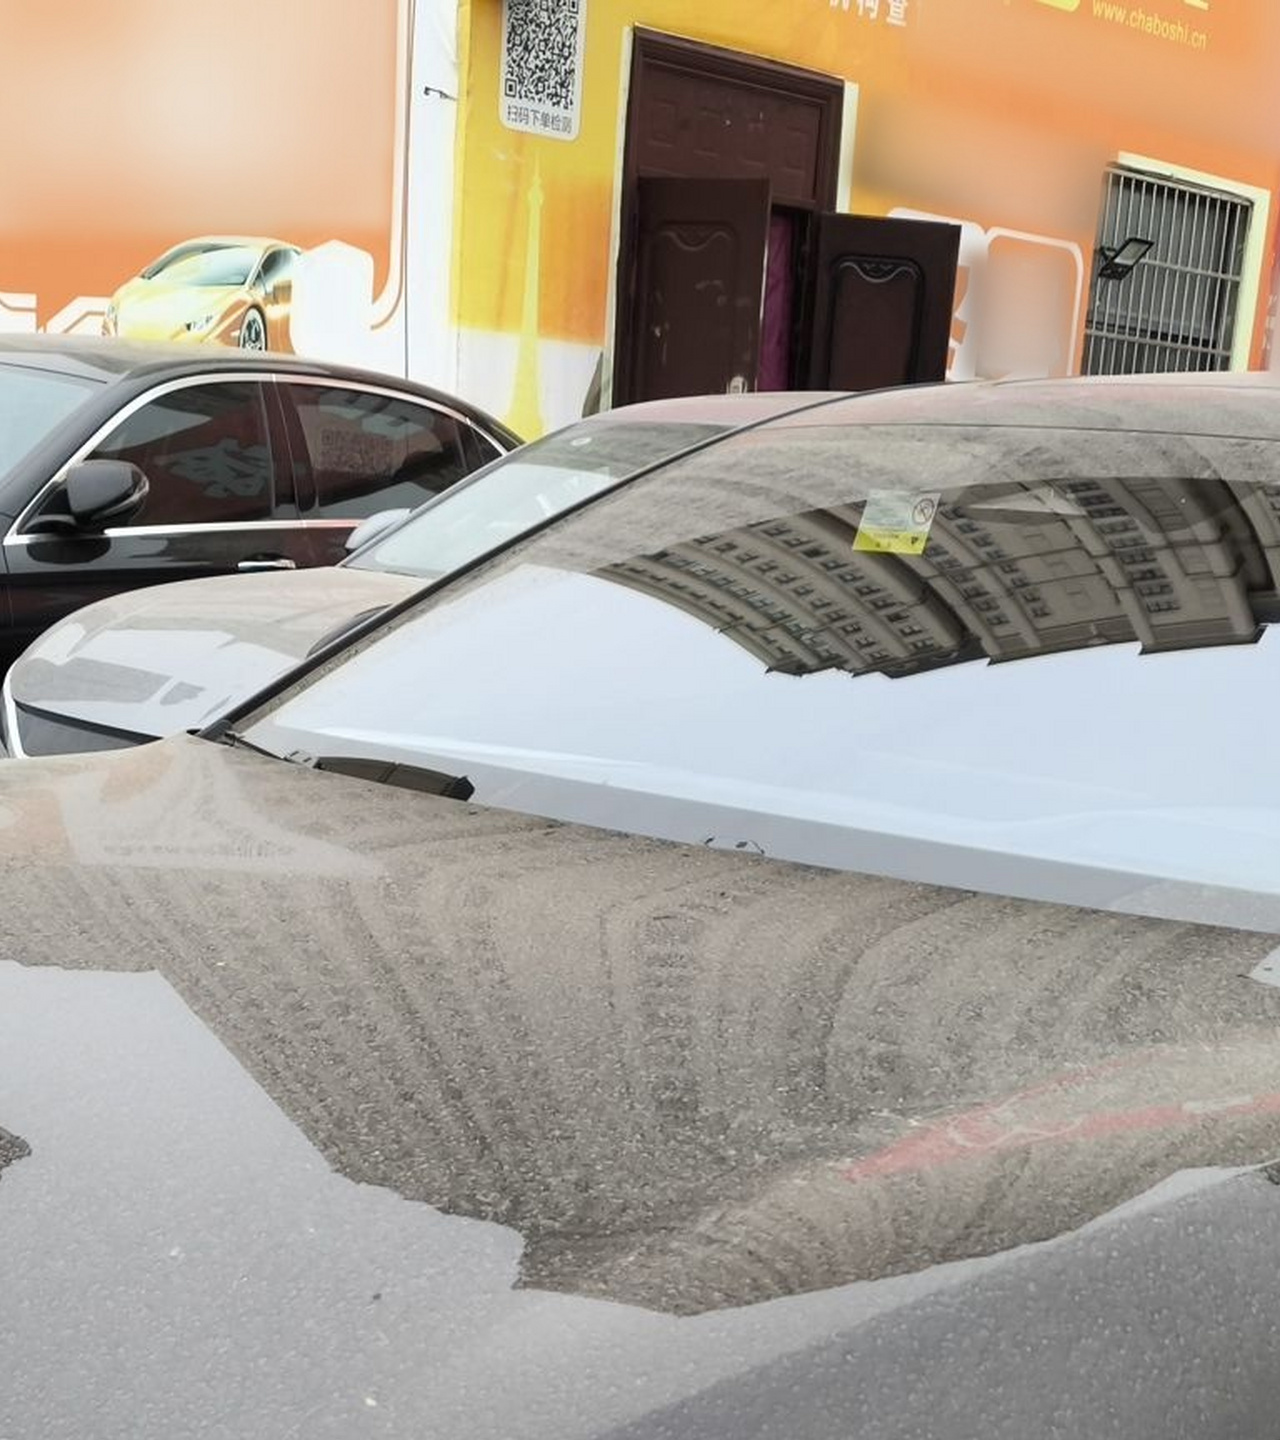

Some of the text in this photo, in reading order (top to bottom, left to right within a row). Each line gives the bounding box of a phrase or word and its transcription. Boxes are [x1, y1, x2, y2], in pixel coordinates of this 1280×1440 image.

[507, 104, 573, 133] 扫码下单检测
